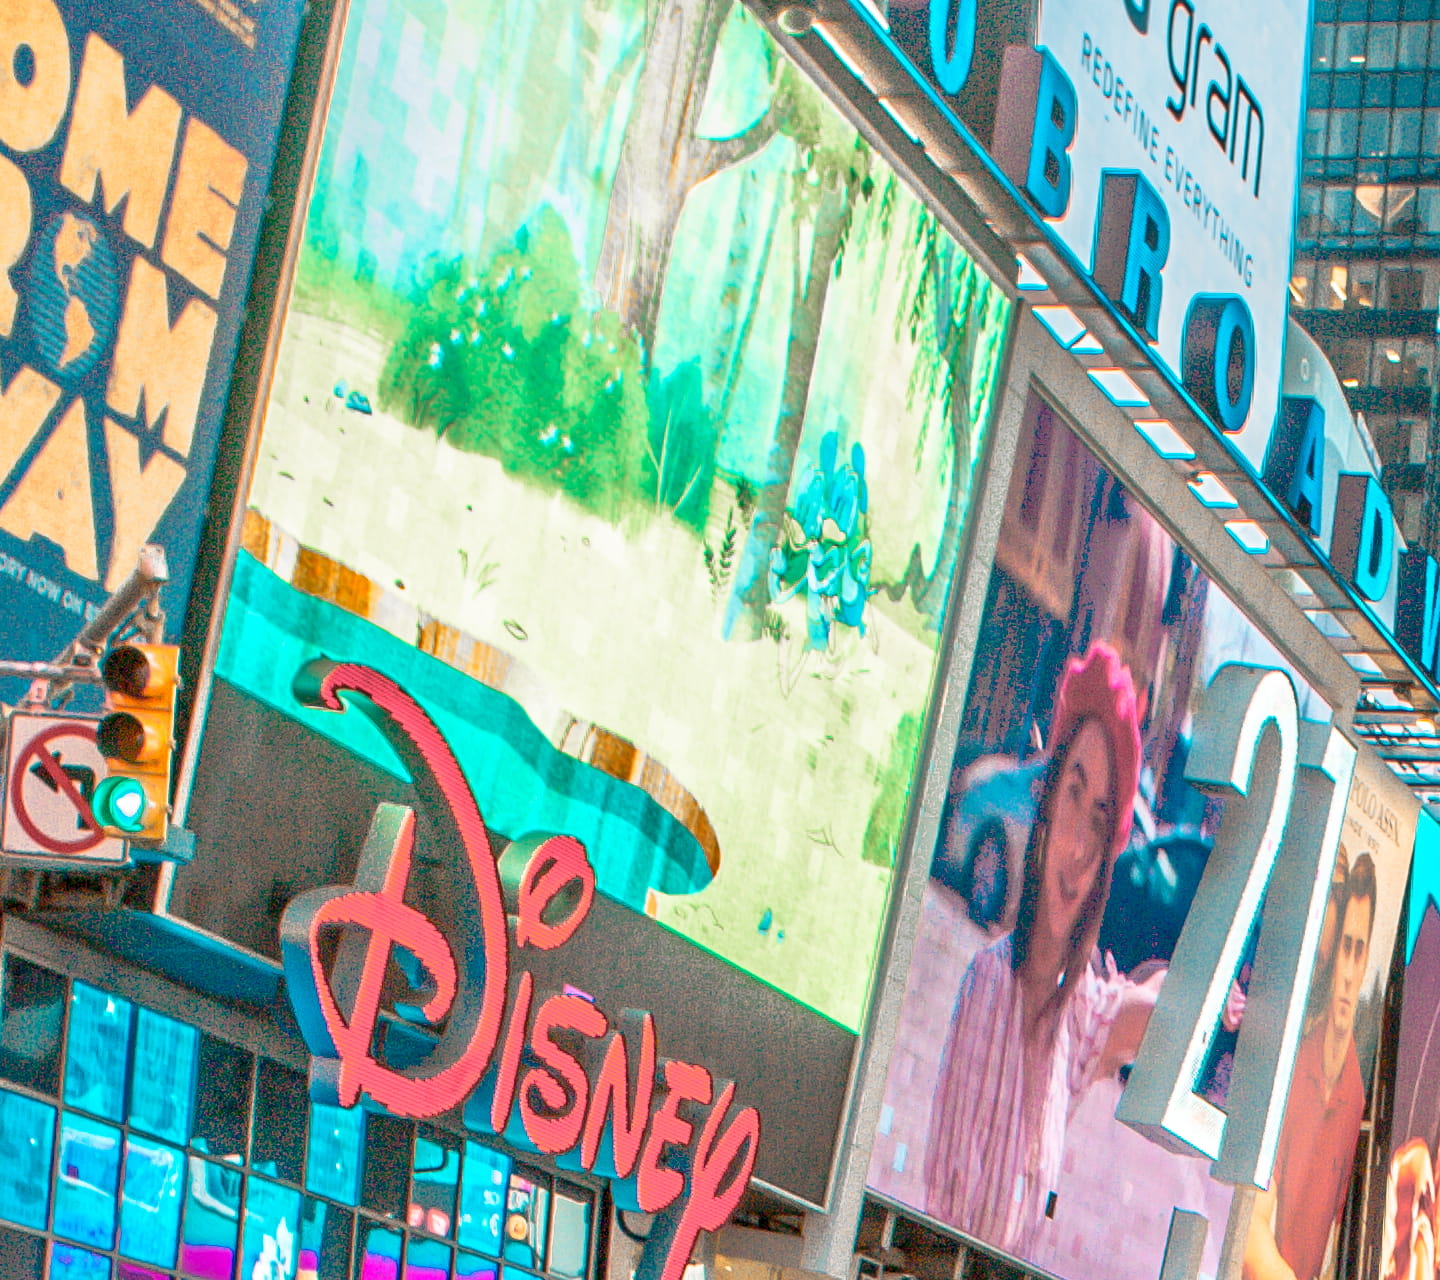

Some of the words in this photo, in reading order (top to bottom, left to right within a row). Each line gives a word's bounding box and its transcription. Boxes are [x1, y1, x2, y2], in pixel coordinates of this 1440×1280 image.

[1081, 33, 1160, 165] REDEFINE
[1163, 145, 1254, 288] EVERYTHING
[1158, 658, 1359, 1192] 21
